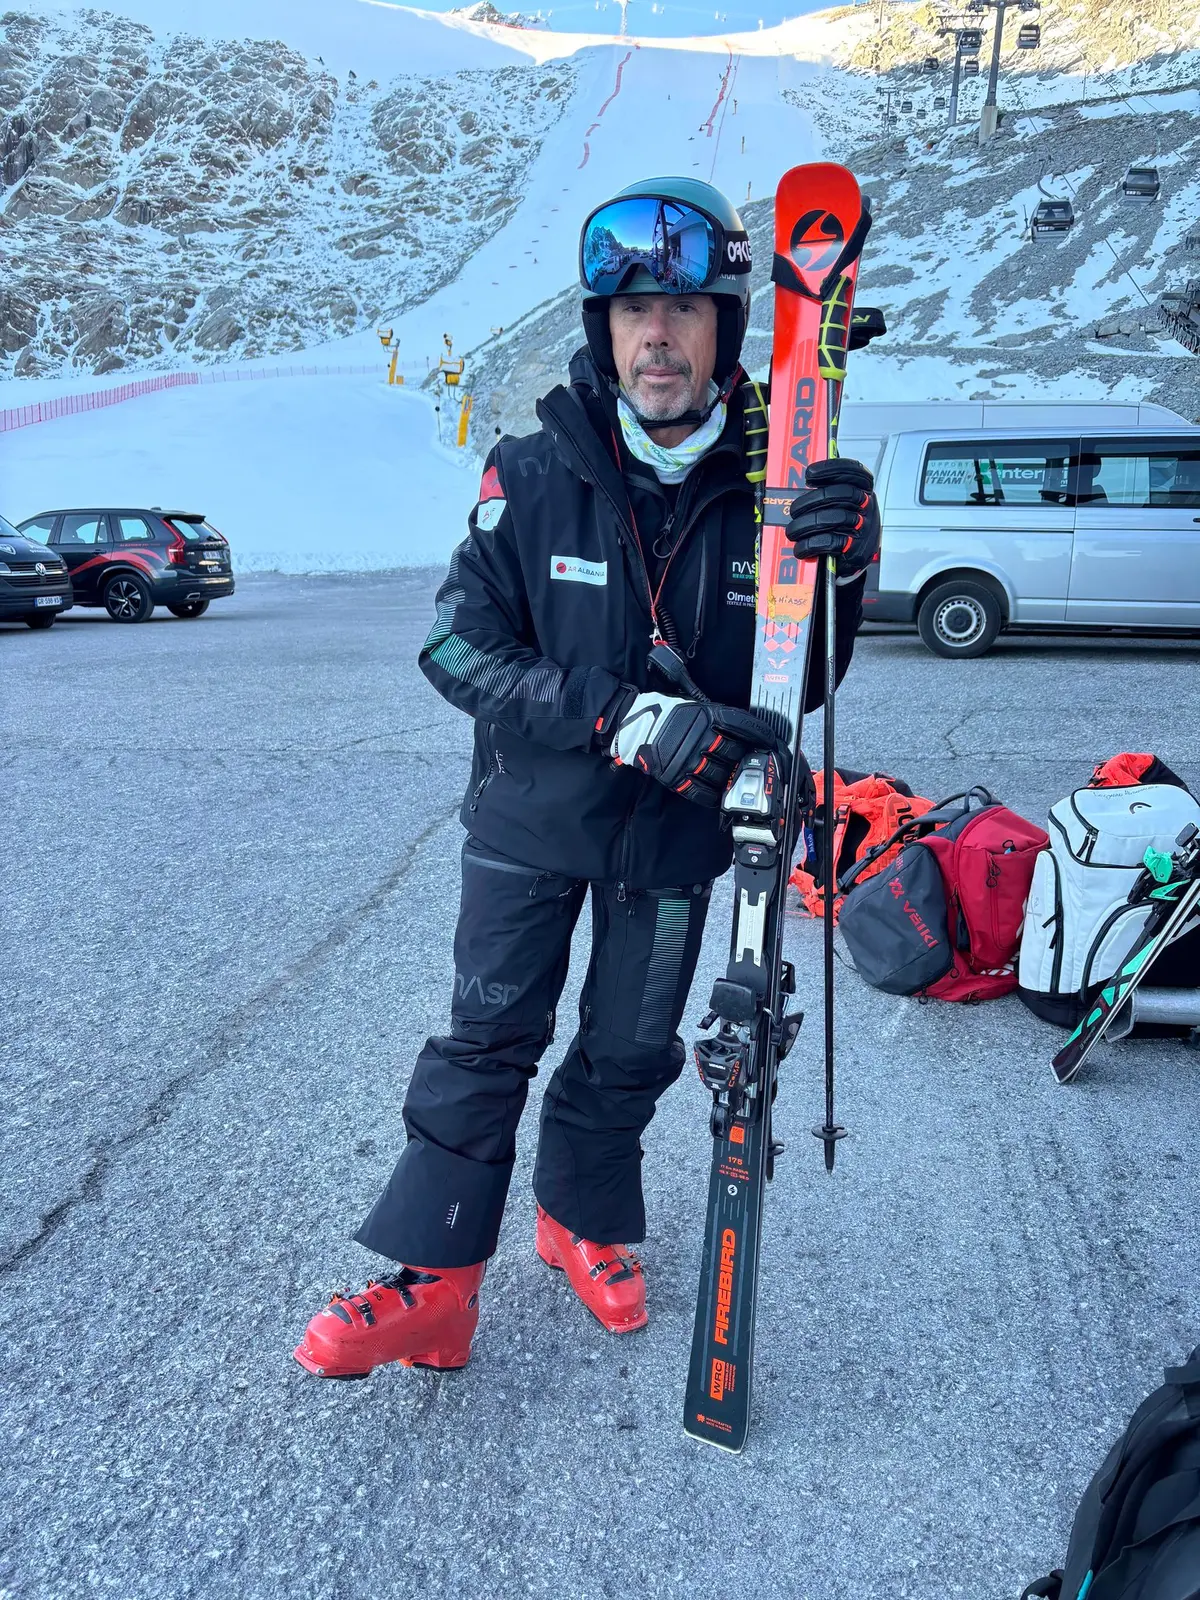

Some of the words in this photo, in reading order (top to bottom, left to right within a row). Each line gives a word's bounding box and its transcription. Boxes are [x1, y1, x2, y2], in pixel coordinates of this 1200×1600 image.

[727, 240, 752, 263] OAKLE
[778, 376, 817, 585] BLZARD
[726, 591, 756, 603] Olmet
[714, 1228, 736, 1345] FIREBIRD
[713, 1361, 724, 1395] WRC
